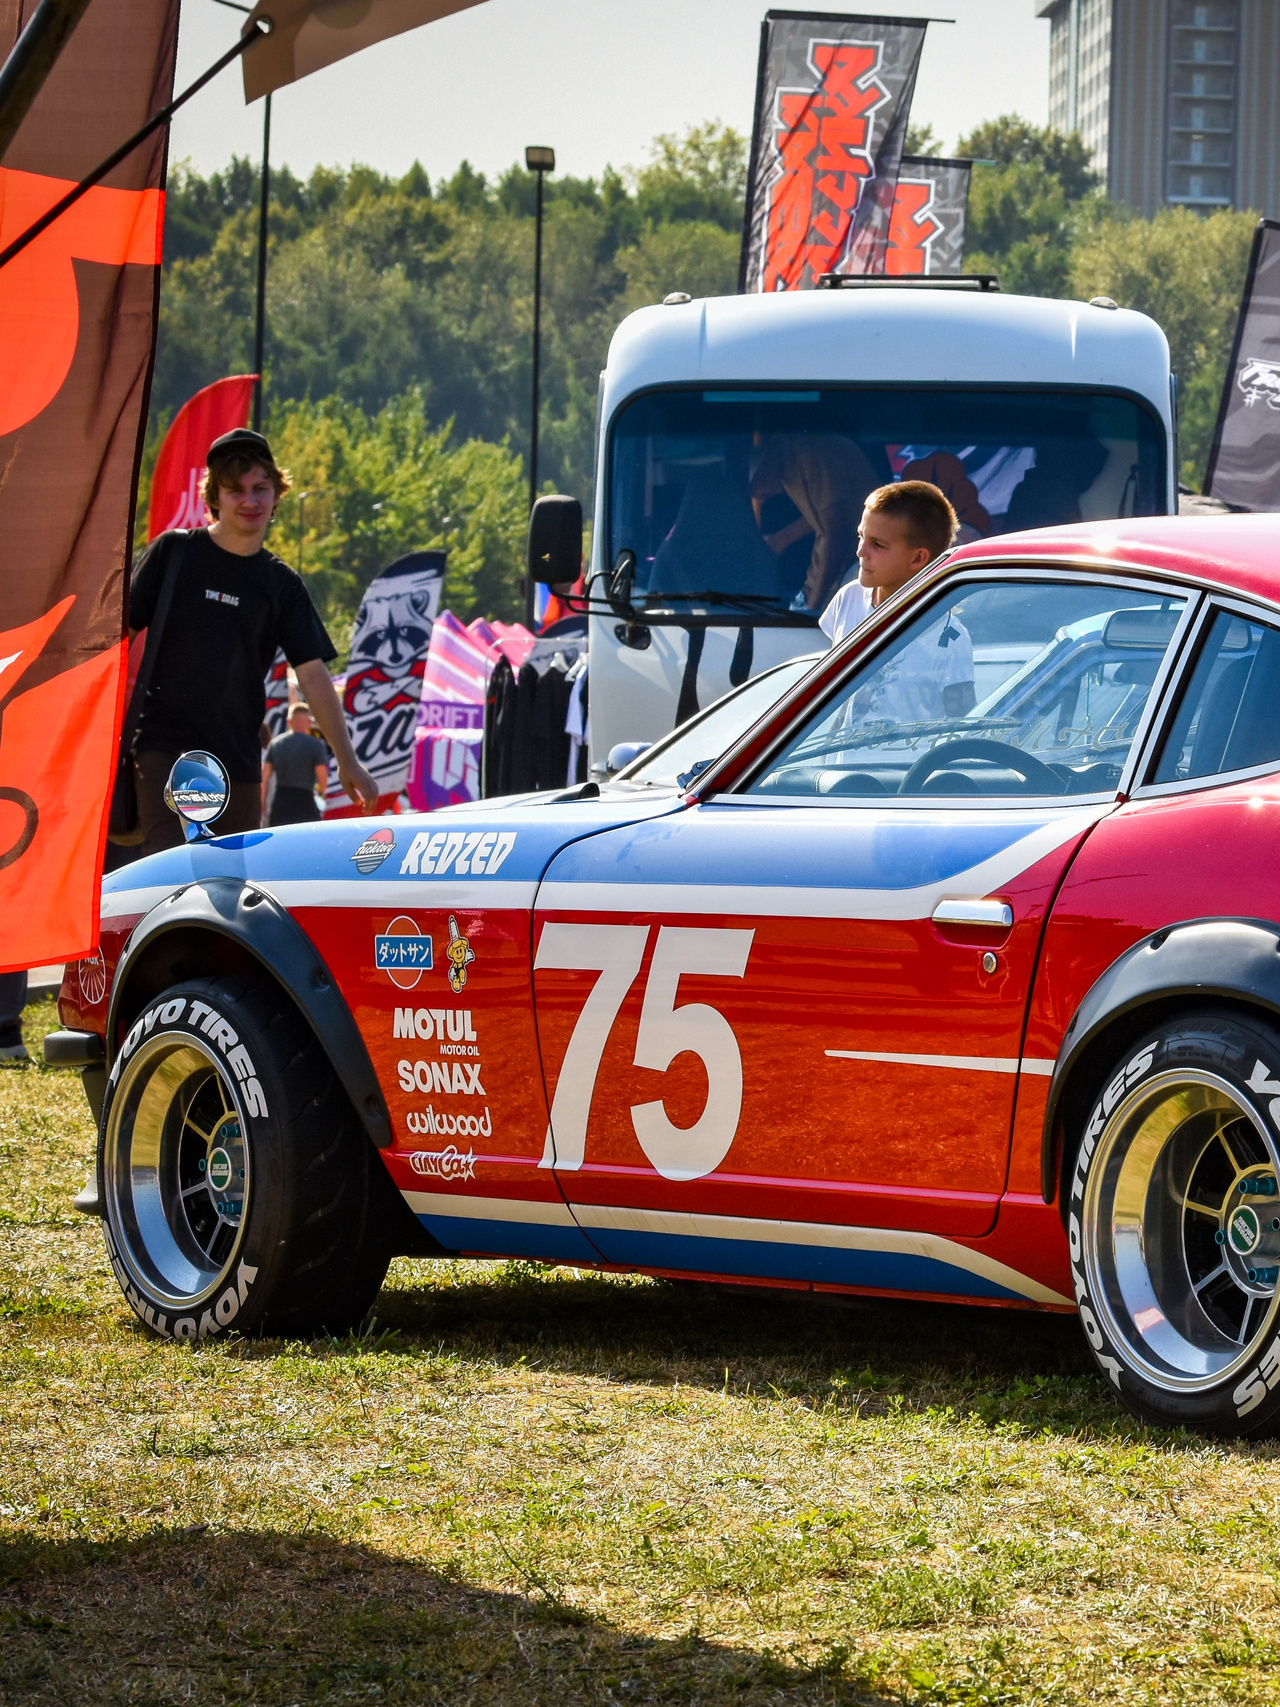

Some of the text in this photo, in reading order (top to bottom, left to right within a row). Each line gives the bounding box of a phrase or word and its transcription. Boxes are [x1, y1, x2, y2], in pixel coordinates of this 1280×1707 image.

[398, 832, 518, 875] REDZED
[378, 942, 430, 963] ダットサン
[392, 1007, 478, 1042] MOTUL
[186, 999, 270, 1119] TIRES
[439, 1044, 480, 1056] MOTOR OIL
[533, 921, 756, 1181] 75
[397, 1059, 487, 1096] SONAX
[406, 1104, 493, 1138] wilwood
